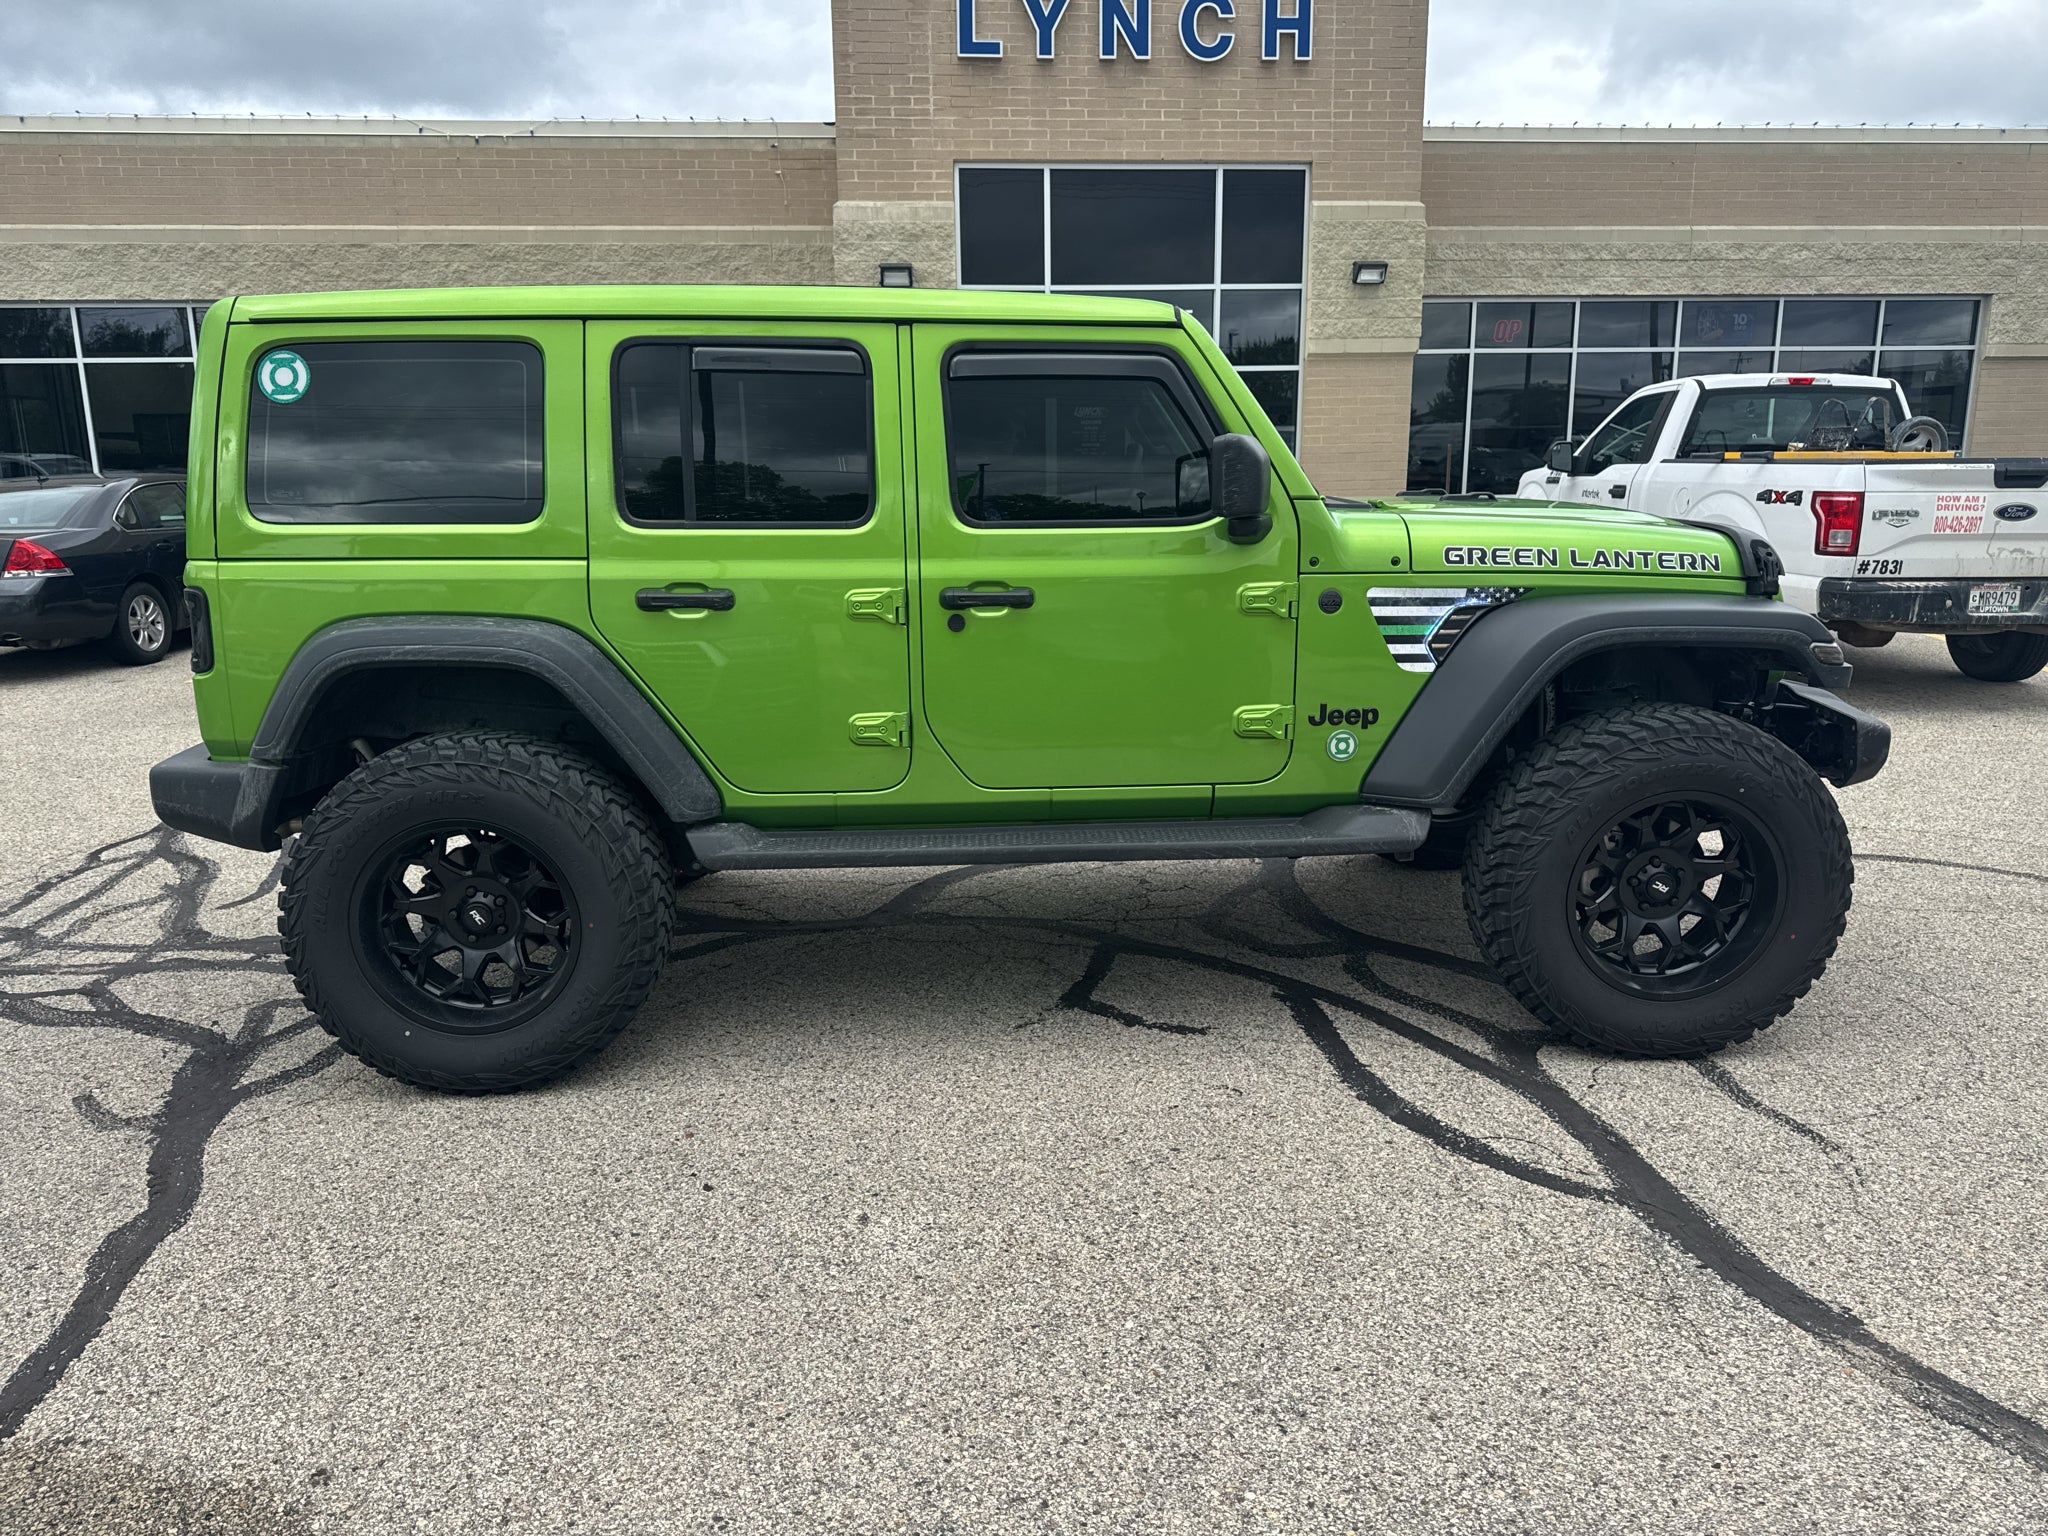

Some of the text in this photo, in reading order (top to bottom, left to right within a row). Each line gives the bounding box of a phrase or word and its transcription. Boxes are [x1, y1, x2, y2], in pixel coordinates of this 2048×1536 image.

[956, 0, 1313, 62] LYNCH
[1936, 495, 1962, 503] HOW
[1964, 496, 1981, 504] AM
[1936, 503, 1986, 512] DRIVING?
[2004, 506, 2029, 518] Ford
[1933, 516, 1983, 533] 800-426-2897
[1443, 545, 1721, 572] GREEN LANTERN
[1978, 591, 2018, 606] MR9479
[1307, 702, 1380, 730] Jeep
[1652, 880, 1670, 893] RC
[469, 910, 486, 926] RC
